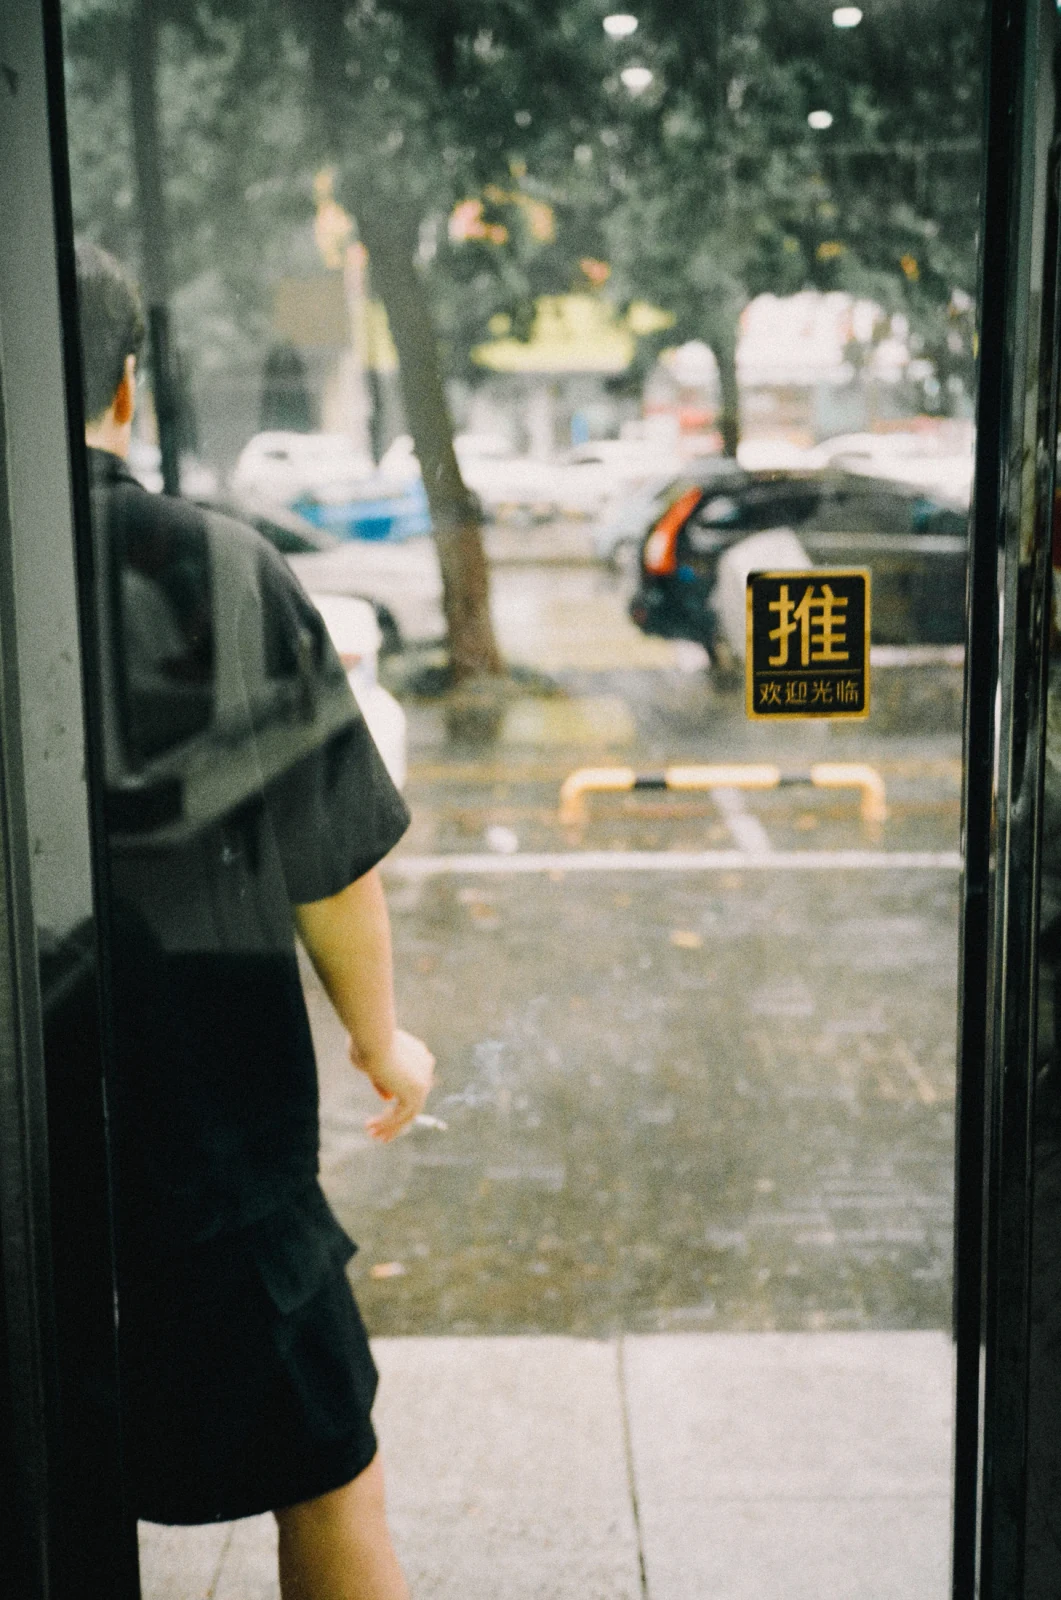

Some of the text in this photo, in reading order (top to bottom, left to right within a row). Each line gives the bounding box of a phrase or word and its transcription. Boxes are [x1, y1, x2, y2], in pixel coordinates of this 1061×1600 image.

[768, 584, 849, 667] 推
[759, 679, 859, 705] 欢迎光临
